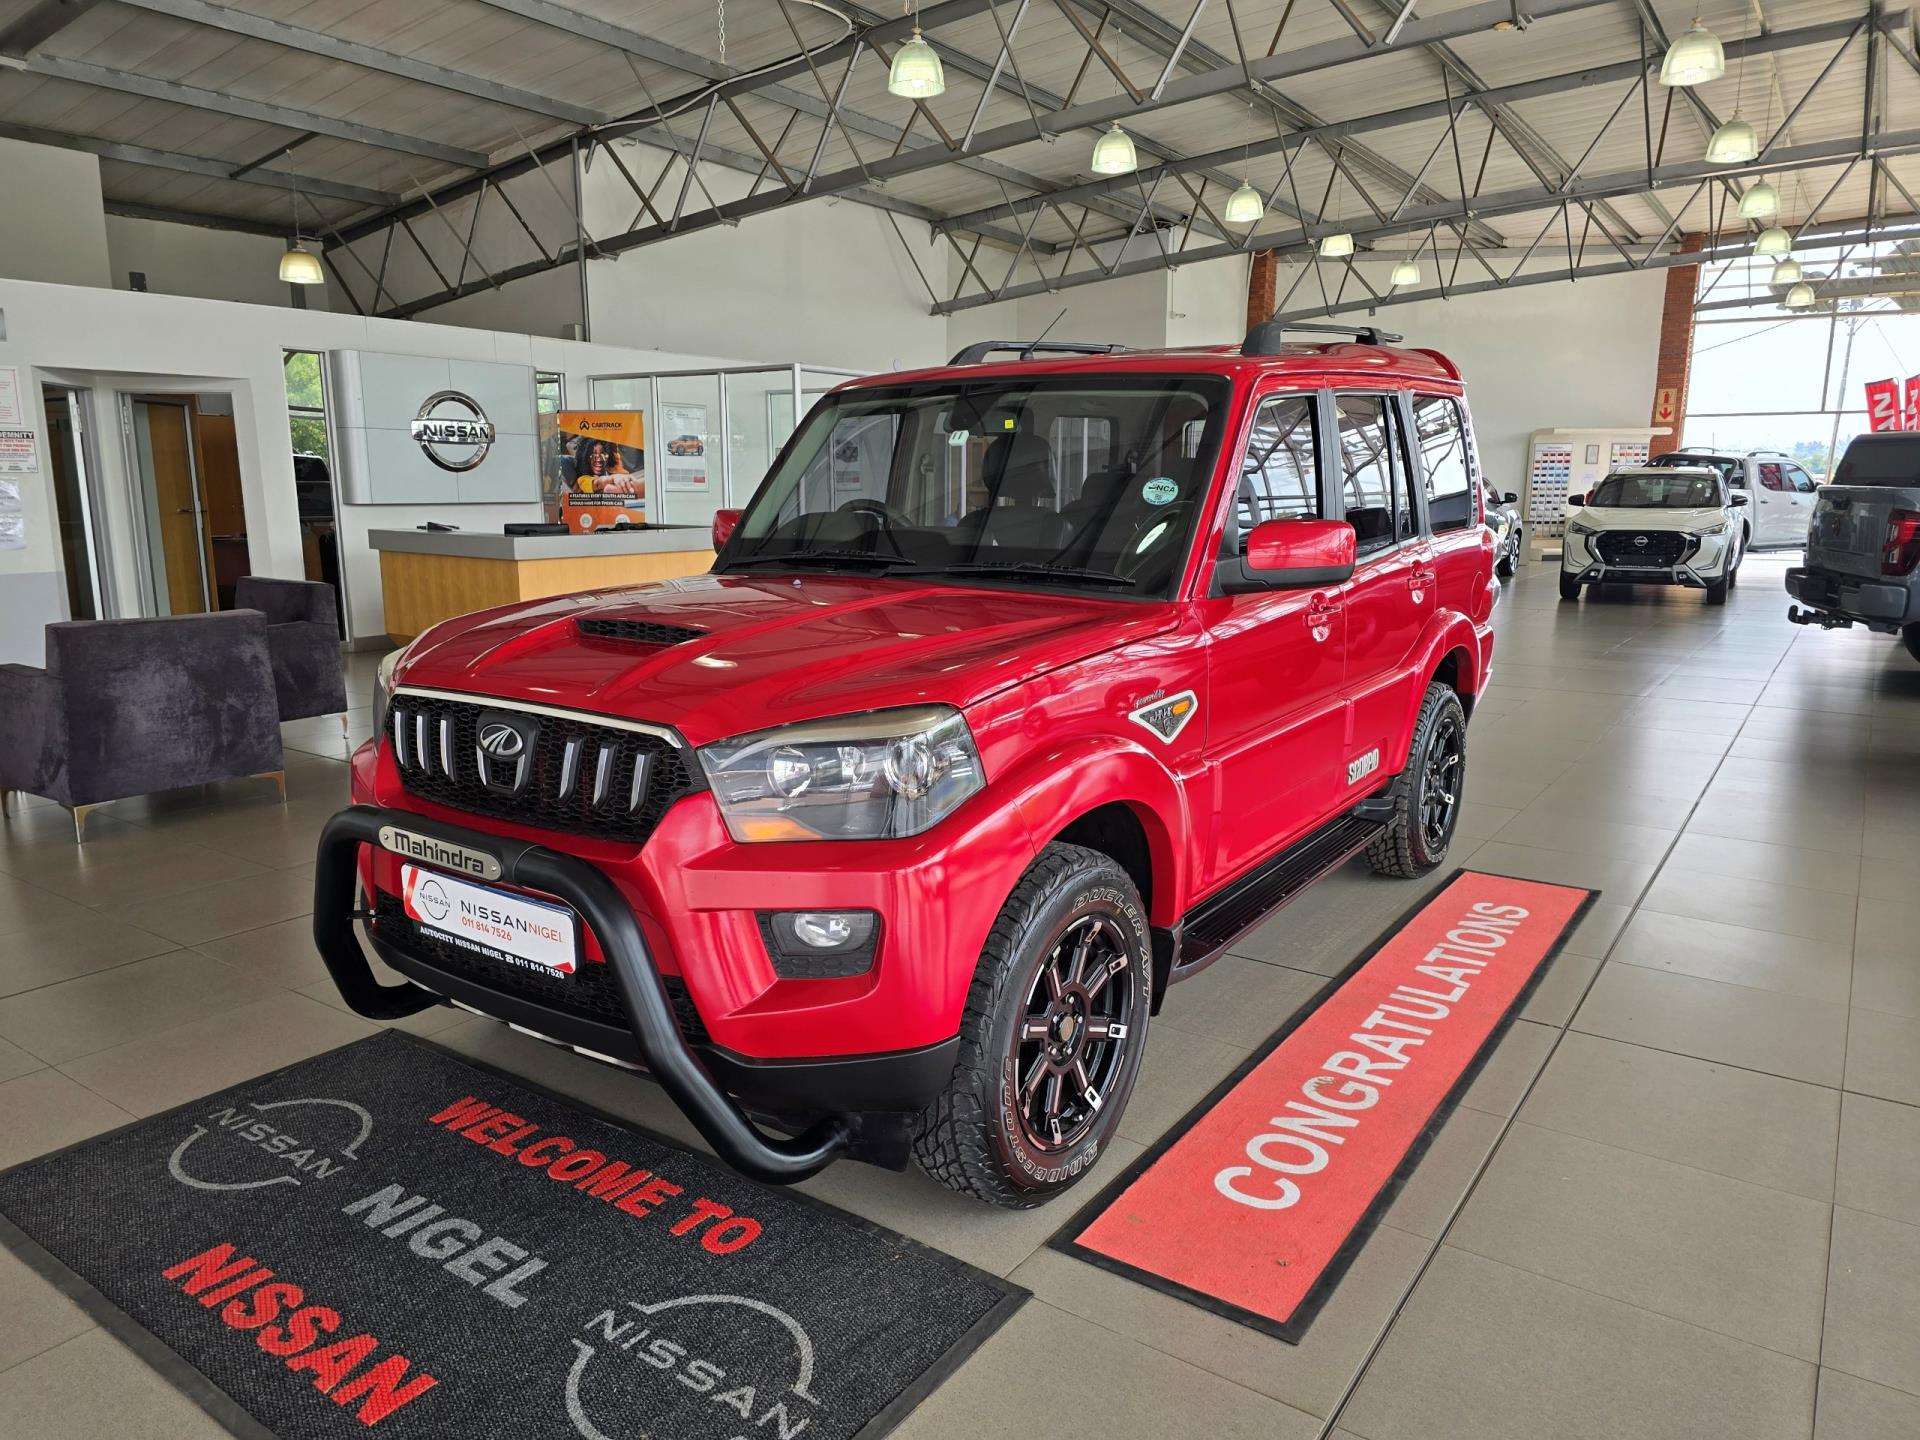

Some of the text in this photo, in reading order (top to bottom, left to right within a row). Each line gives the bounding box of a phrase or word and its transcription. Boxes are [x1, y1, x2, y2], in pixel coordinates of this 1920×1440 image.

[423, 424, 489, 439] NISSAN
[394, 832, 484, 874] Mahindra
[419, 892, 451, 908] NISSAN
[462, 916, 512, 941] 011 814 7526
[1071, 887, 1144, 937] DUELER
[420, 926, 565, 979] AUTOCITY NISSAN NIGEL 011 814 7526
[1214, 901, 1530, 1210] CONGRATULATIONS
[207, 1106, 345, 1179] NISSAN
[427, 1096, 762, 1255] WELCOME TO
[342, 1184, 549, 1308] NIGEL
[162, 1243, 439, 1427] NISSAN
[584, 1309, 811, 1440] NISSAN
